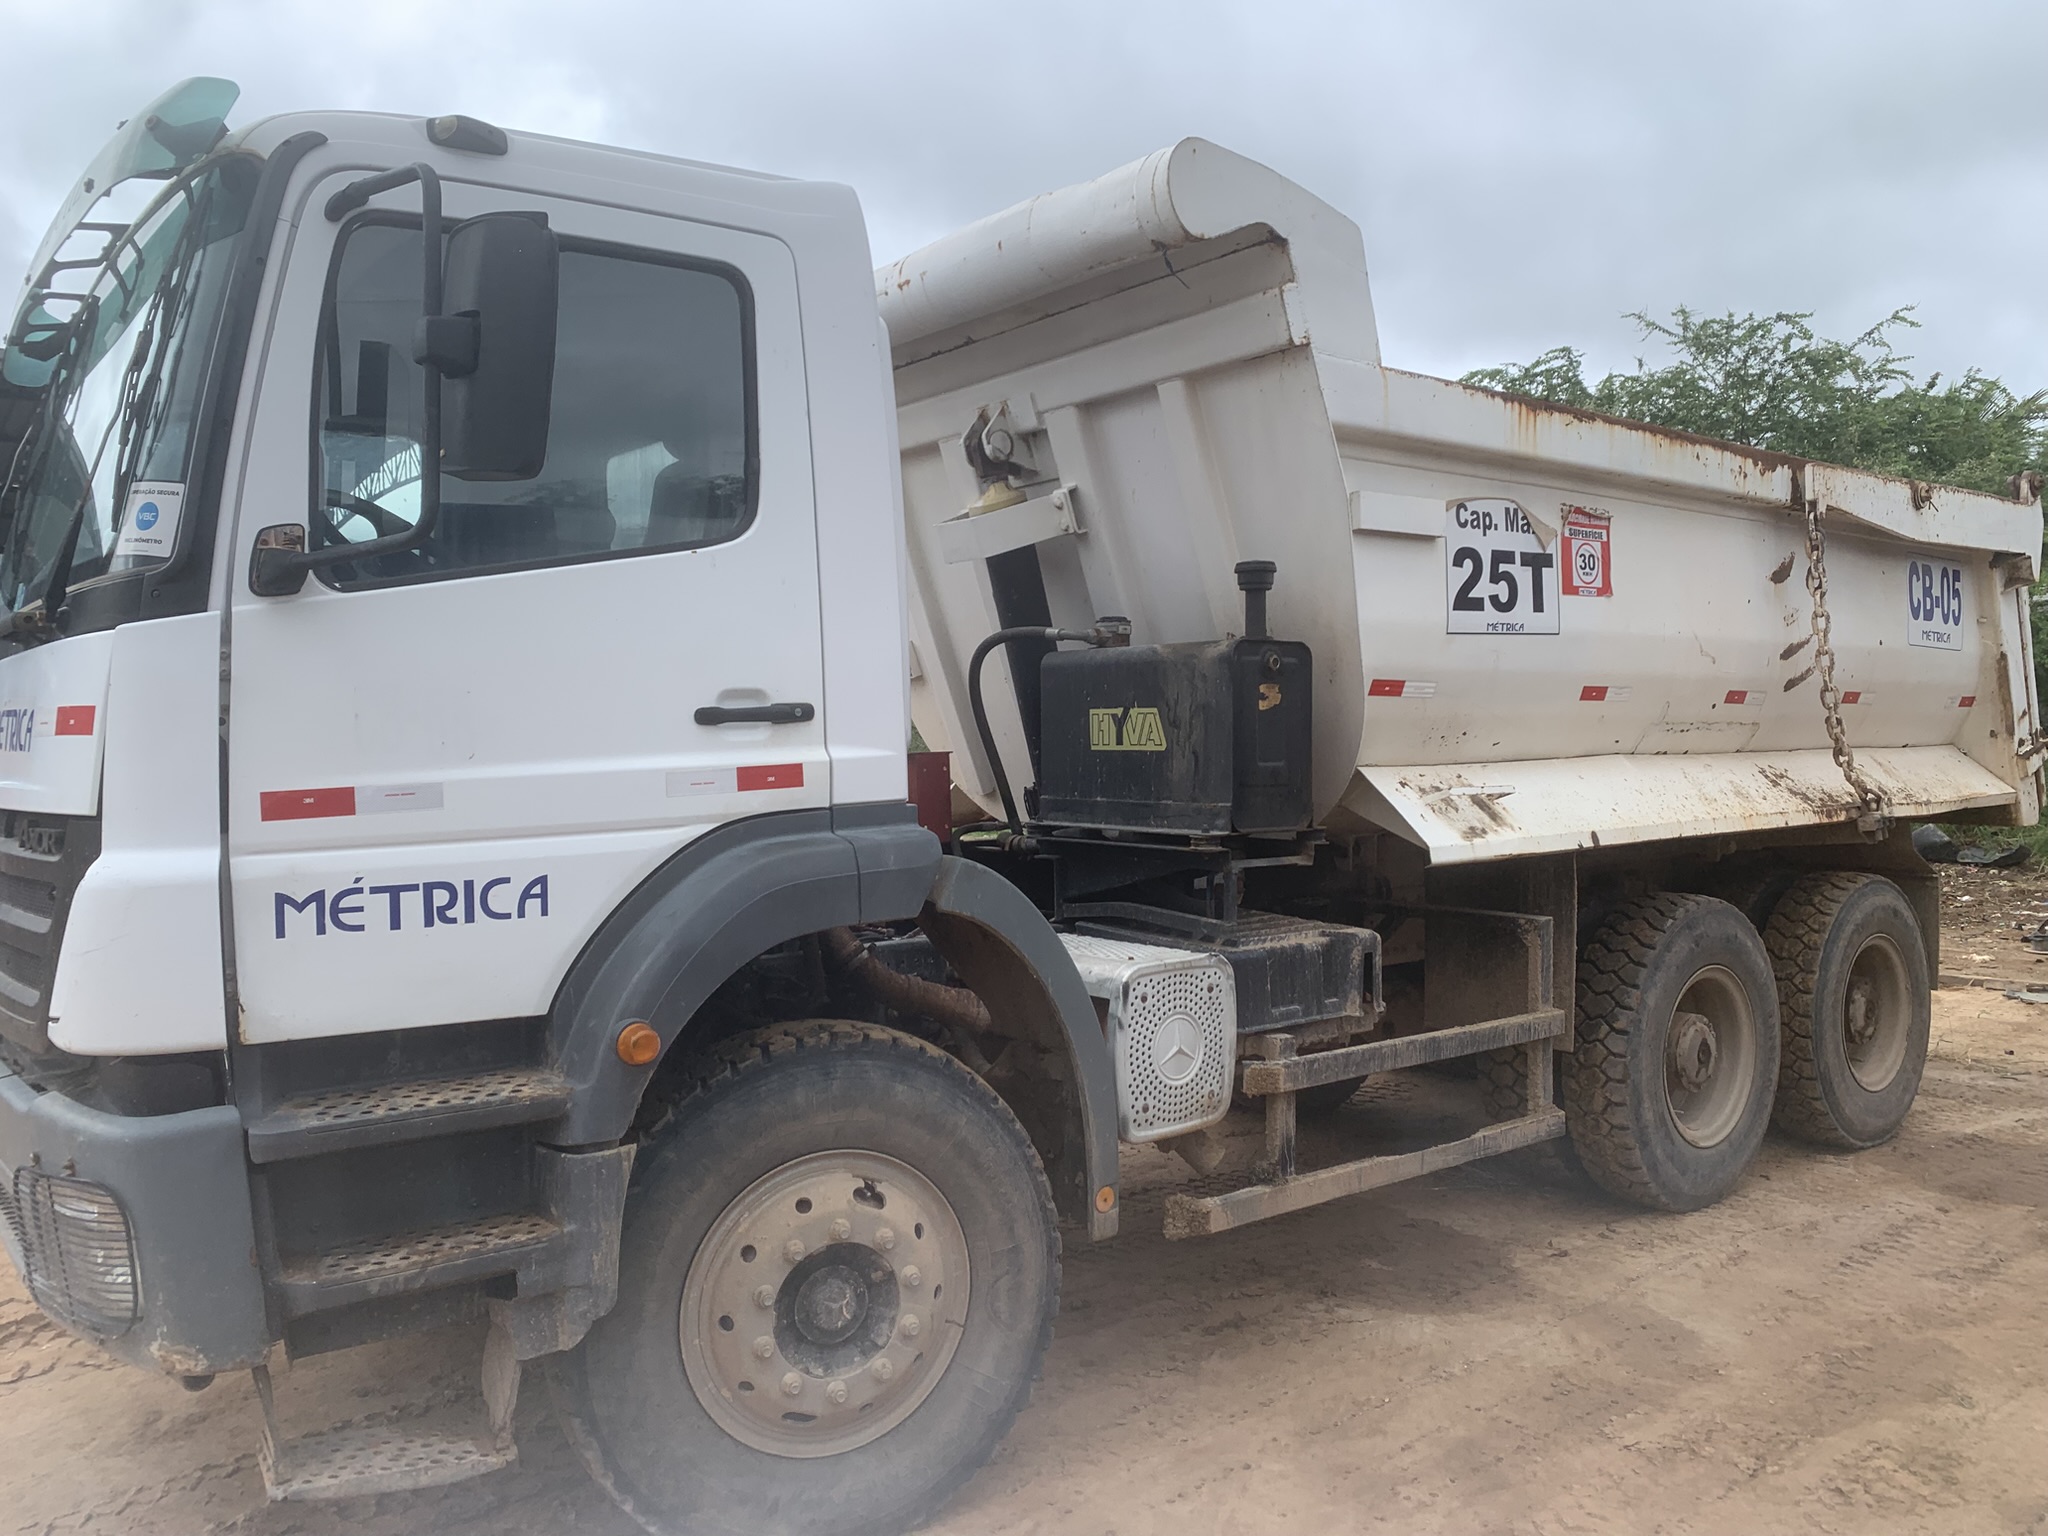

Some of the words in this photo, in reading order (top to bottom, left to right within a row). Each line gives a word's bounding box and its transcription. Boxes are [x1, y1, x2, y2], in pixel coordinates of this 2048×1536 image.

[138, 512, 156, 521] VBC
[1455, 502, 1498, 537] Cap.
[1504, 506, 1537, 535] Ma
[1452, 546, 1554, 614] 25T
[1579, 553, 1596, 571] 30
[1908, 560, 1962, 627] CB-05
[1486, 622, 1525, 632] MÉTRICA
[1091, 706, 1163, 747] HYVA
[274, 873, 549, 939] MÉTRICA
